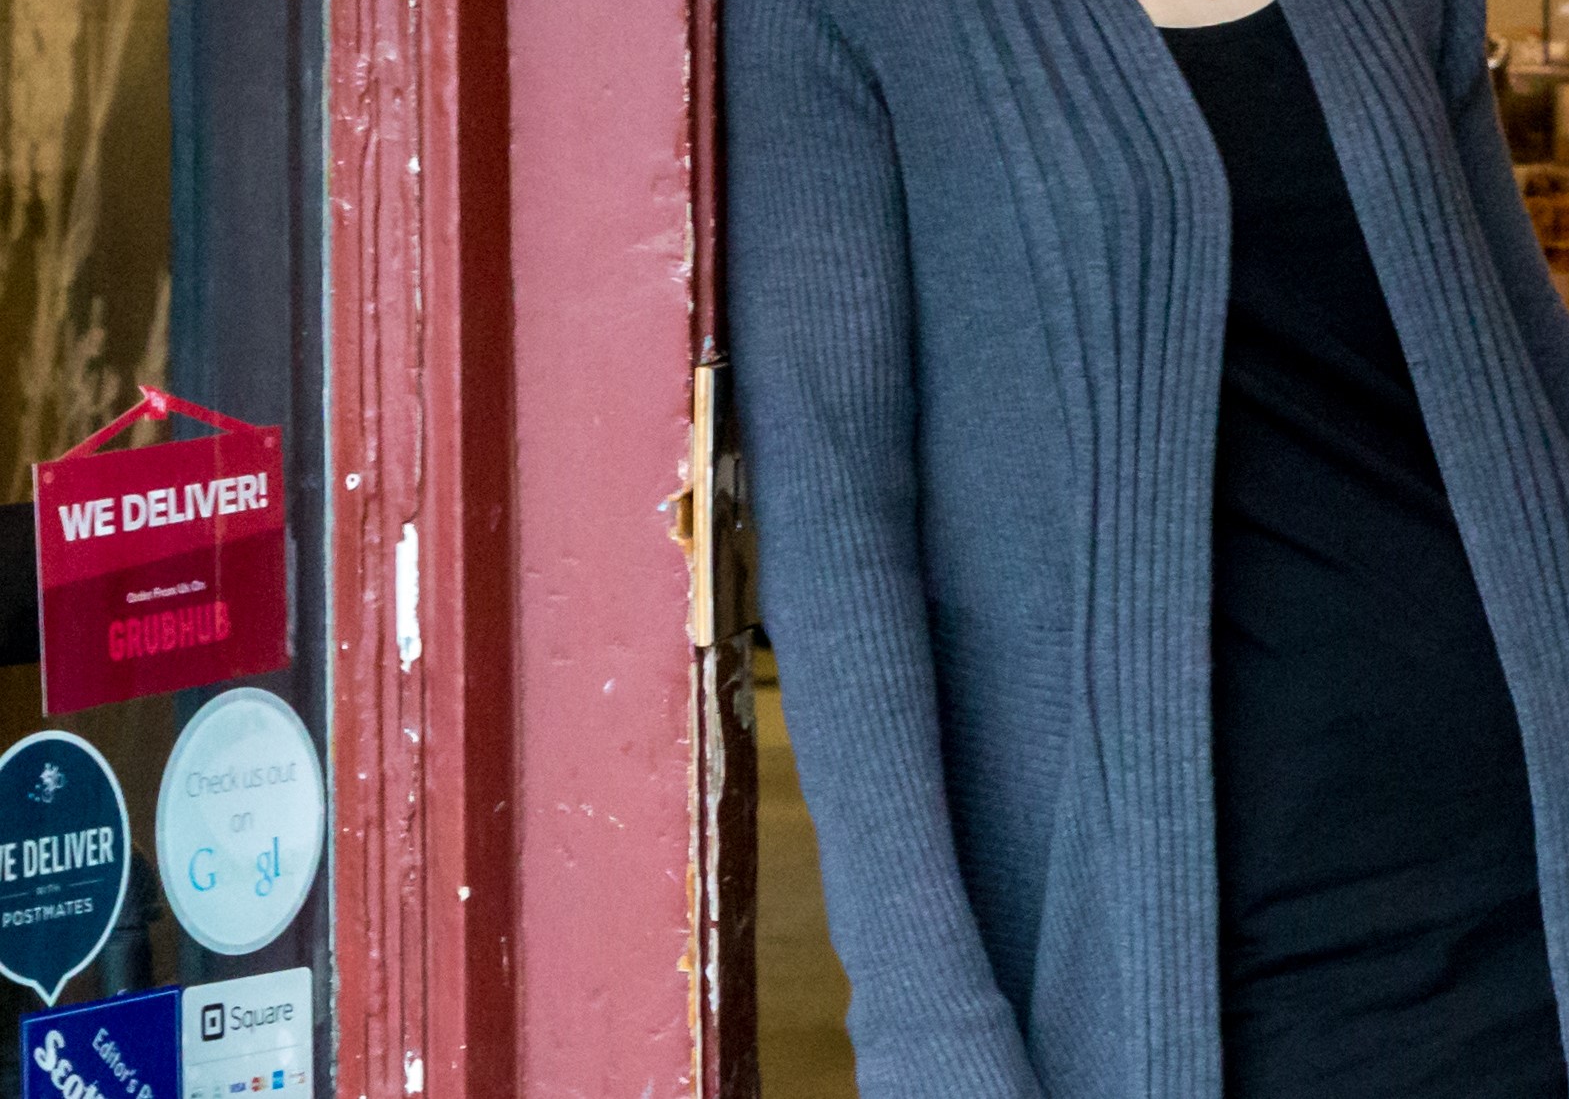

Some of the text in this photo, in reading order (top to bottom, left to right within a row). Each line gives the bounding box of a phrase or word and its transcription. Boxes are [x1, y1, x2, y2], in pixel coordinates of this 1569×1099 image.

[58, 472, 268, 542] WE DELIVER!
[109, 601, 231, 661] GRUBHUB
[186, 763, 297, 798] Check us out
[231, 811, 253, 833] on
[0, 826, 114, 882] E DELIVER
[2, 898, 93, 927] POSTMATES
[230, 1001, 294, 1033] Square
